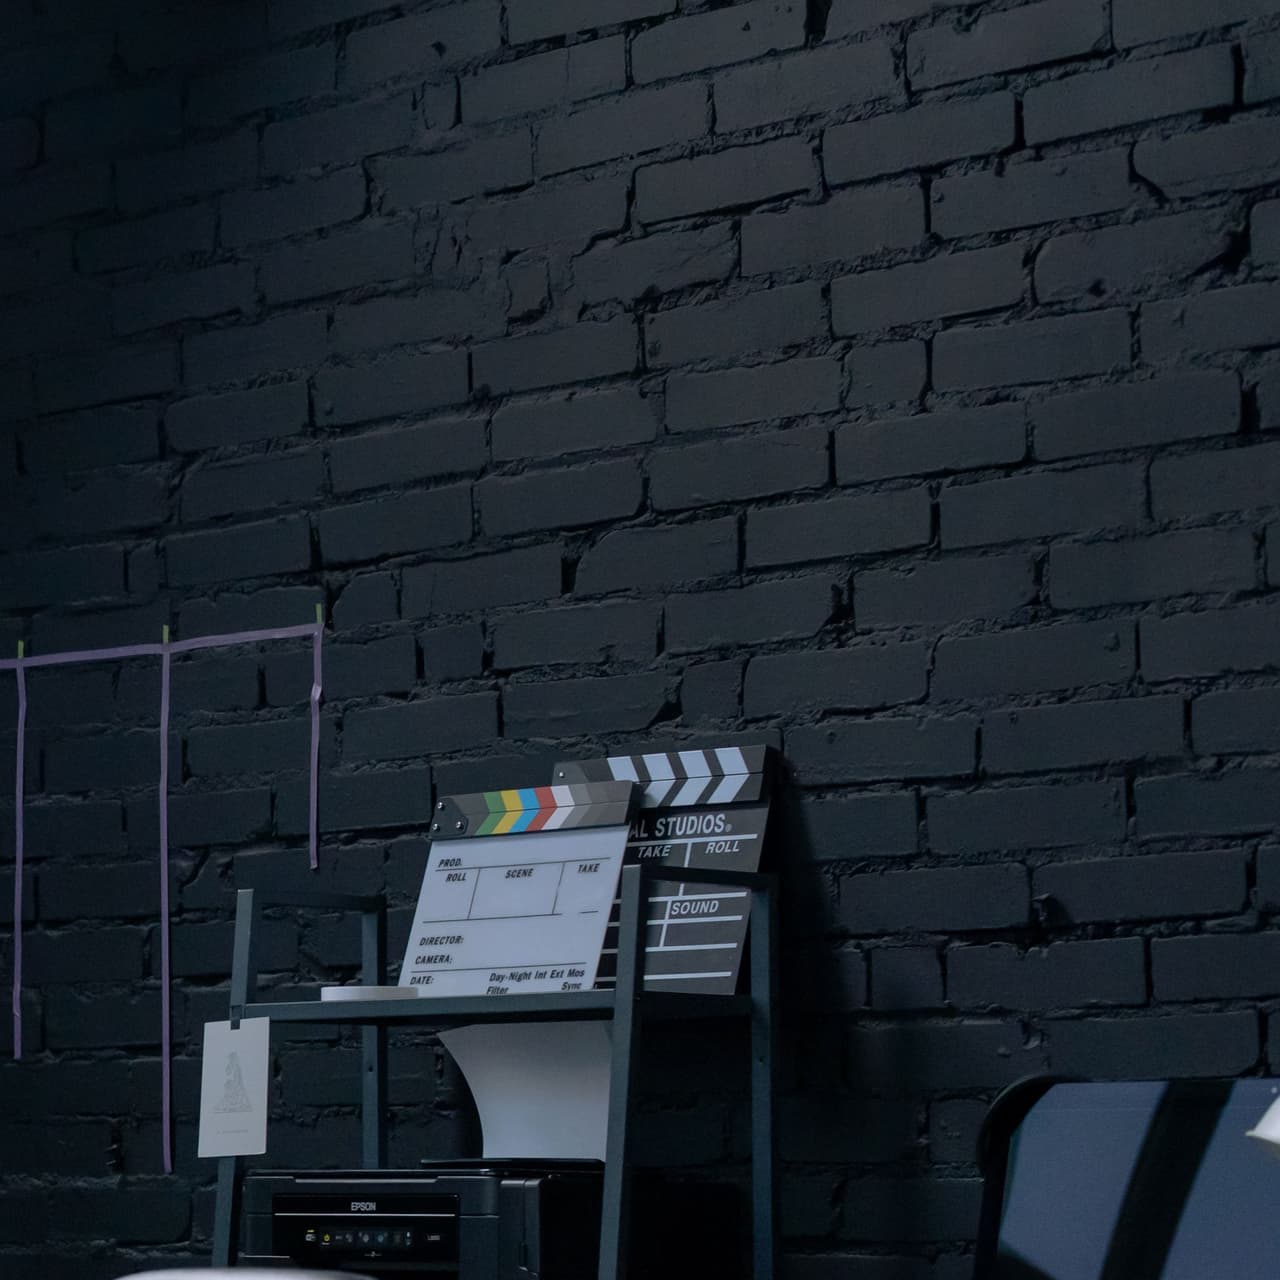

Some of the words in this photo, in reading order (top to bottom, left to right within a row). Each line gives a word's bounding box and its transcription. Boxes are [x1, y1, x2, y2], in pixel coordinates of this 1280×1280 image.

[655, 814, 726, 837] STUDIOS
[637, 845, 672, 858] TAKE
[705, 841, 740, 854] ROLL
[438, 858, 462, 868] PROD.
[578, 864, 600, 873] TAKE
[445, 873, 466, 882] ROLL
[505, 869, 534, 879] SCENE
[671, 901, 719, 915] SOUND
[419, 936, 464, 946] DIRECTOR:
[415, 955, 453, 965] CAMERA:
[490, 971, 531, 983] Day-Night
[534, 970, 548, 980] Int
[550, 968, 563, 979] Ext
[567, 967, 585, 978] Mos
[410, 976, 434, 985] DATE:
[486, 986, 509, 995] Filter
[351, 1202, 376, 1212] EPSON
